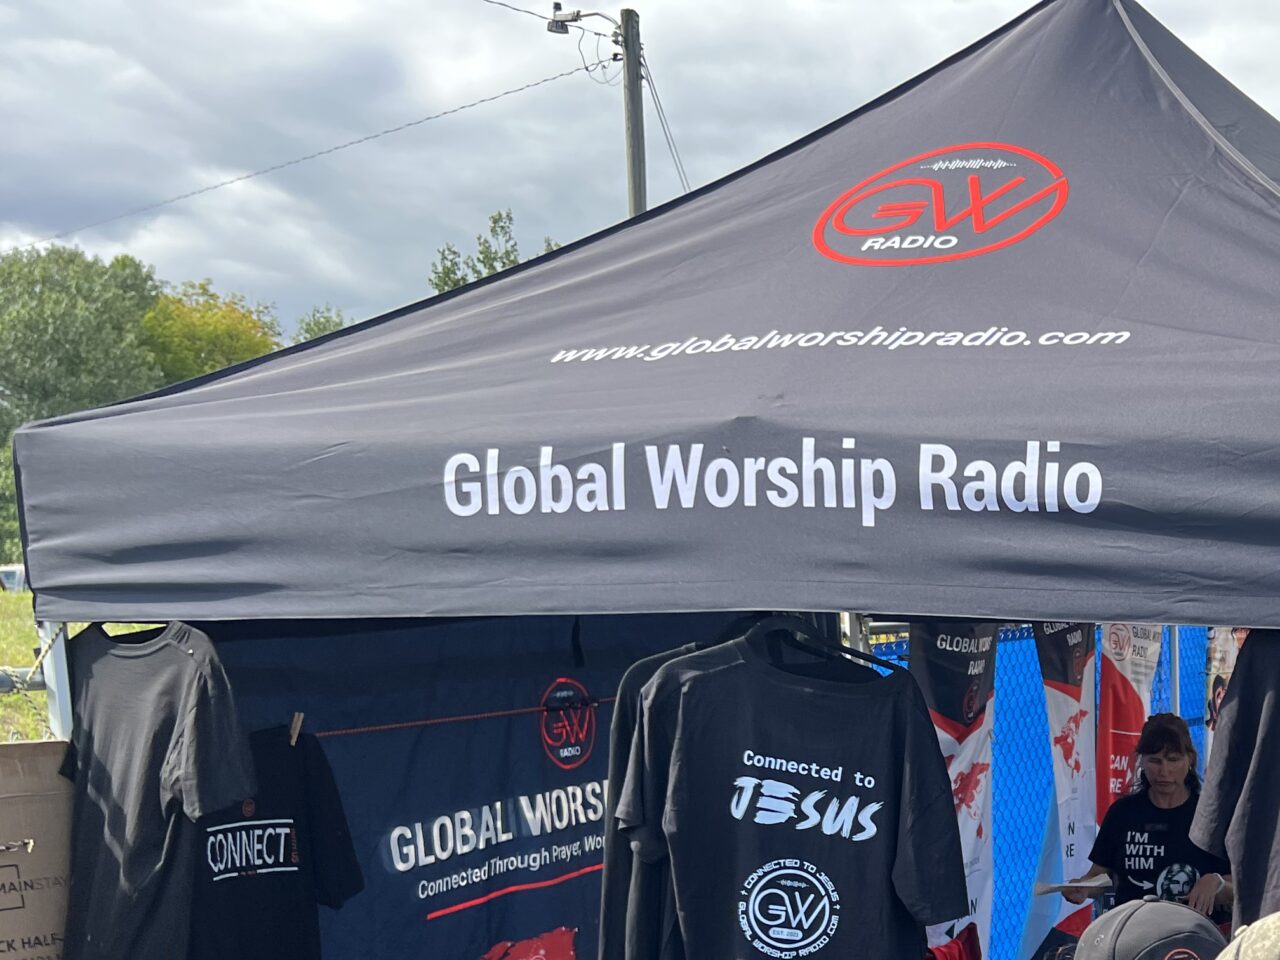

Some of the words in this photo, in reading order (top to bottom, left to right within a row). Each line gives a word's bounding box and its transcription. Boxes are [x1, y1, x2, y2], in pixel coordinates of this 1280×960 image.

[861, 235, 958, 251] RADIO
[550, 325, 1131, 363] www.globalworshipradio.com
[443, 441, 626, 517] Global
[645, 437, 897, 528] Worship
[918, 440, 1103, 515] Radio
[936, 634, 977, 653] GLOBAL
[743, 750, 842, 782] Connected
[854, 771, 875, 788] to
[730, 776, 884, 842] JESUS
[207, 827, 290, 873] CONNECT
[390, 801, 513, 872] GLOBAL
[1125, 843, 1165, 857] WITH
[1126, 830, 1149, 843] I'M
[418, 864, 488, 899] Connected
[490, 847, 550, 877] Through
[553, 843, 582, 863] Prayer,
[744, 859, 800, 888] CONNECTED
[803, 861, 817, 873] TO
[816, 872, 840, 902] JESUS
[1125, 857, 1154, 870] HIM
[754, 888, 828, 929] GW
[738, 902, 752, 941] GLOBAL
[752, 939, 797, 960] WORSHIP
[799, 935, 829, 957] RADIO
